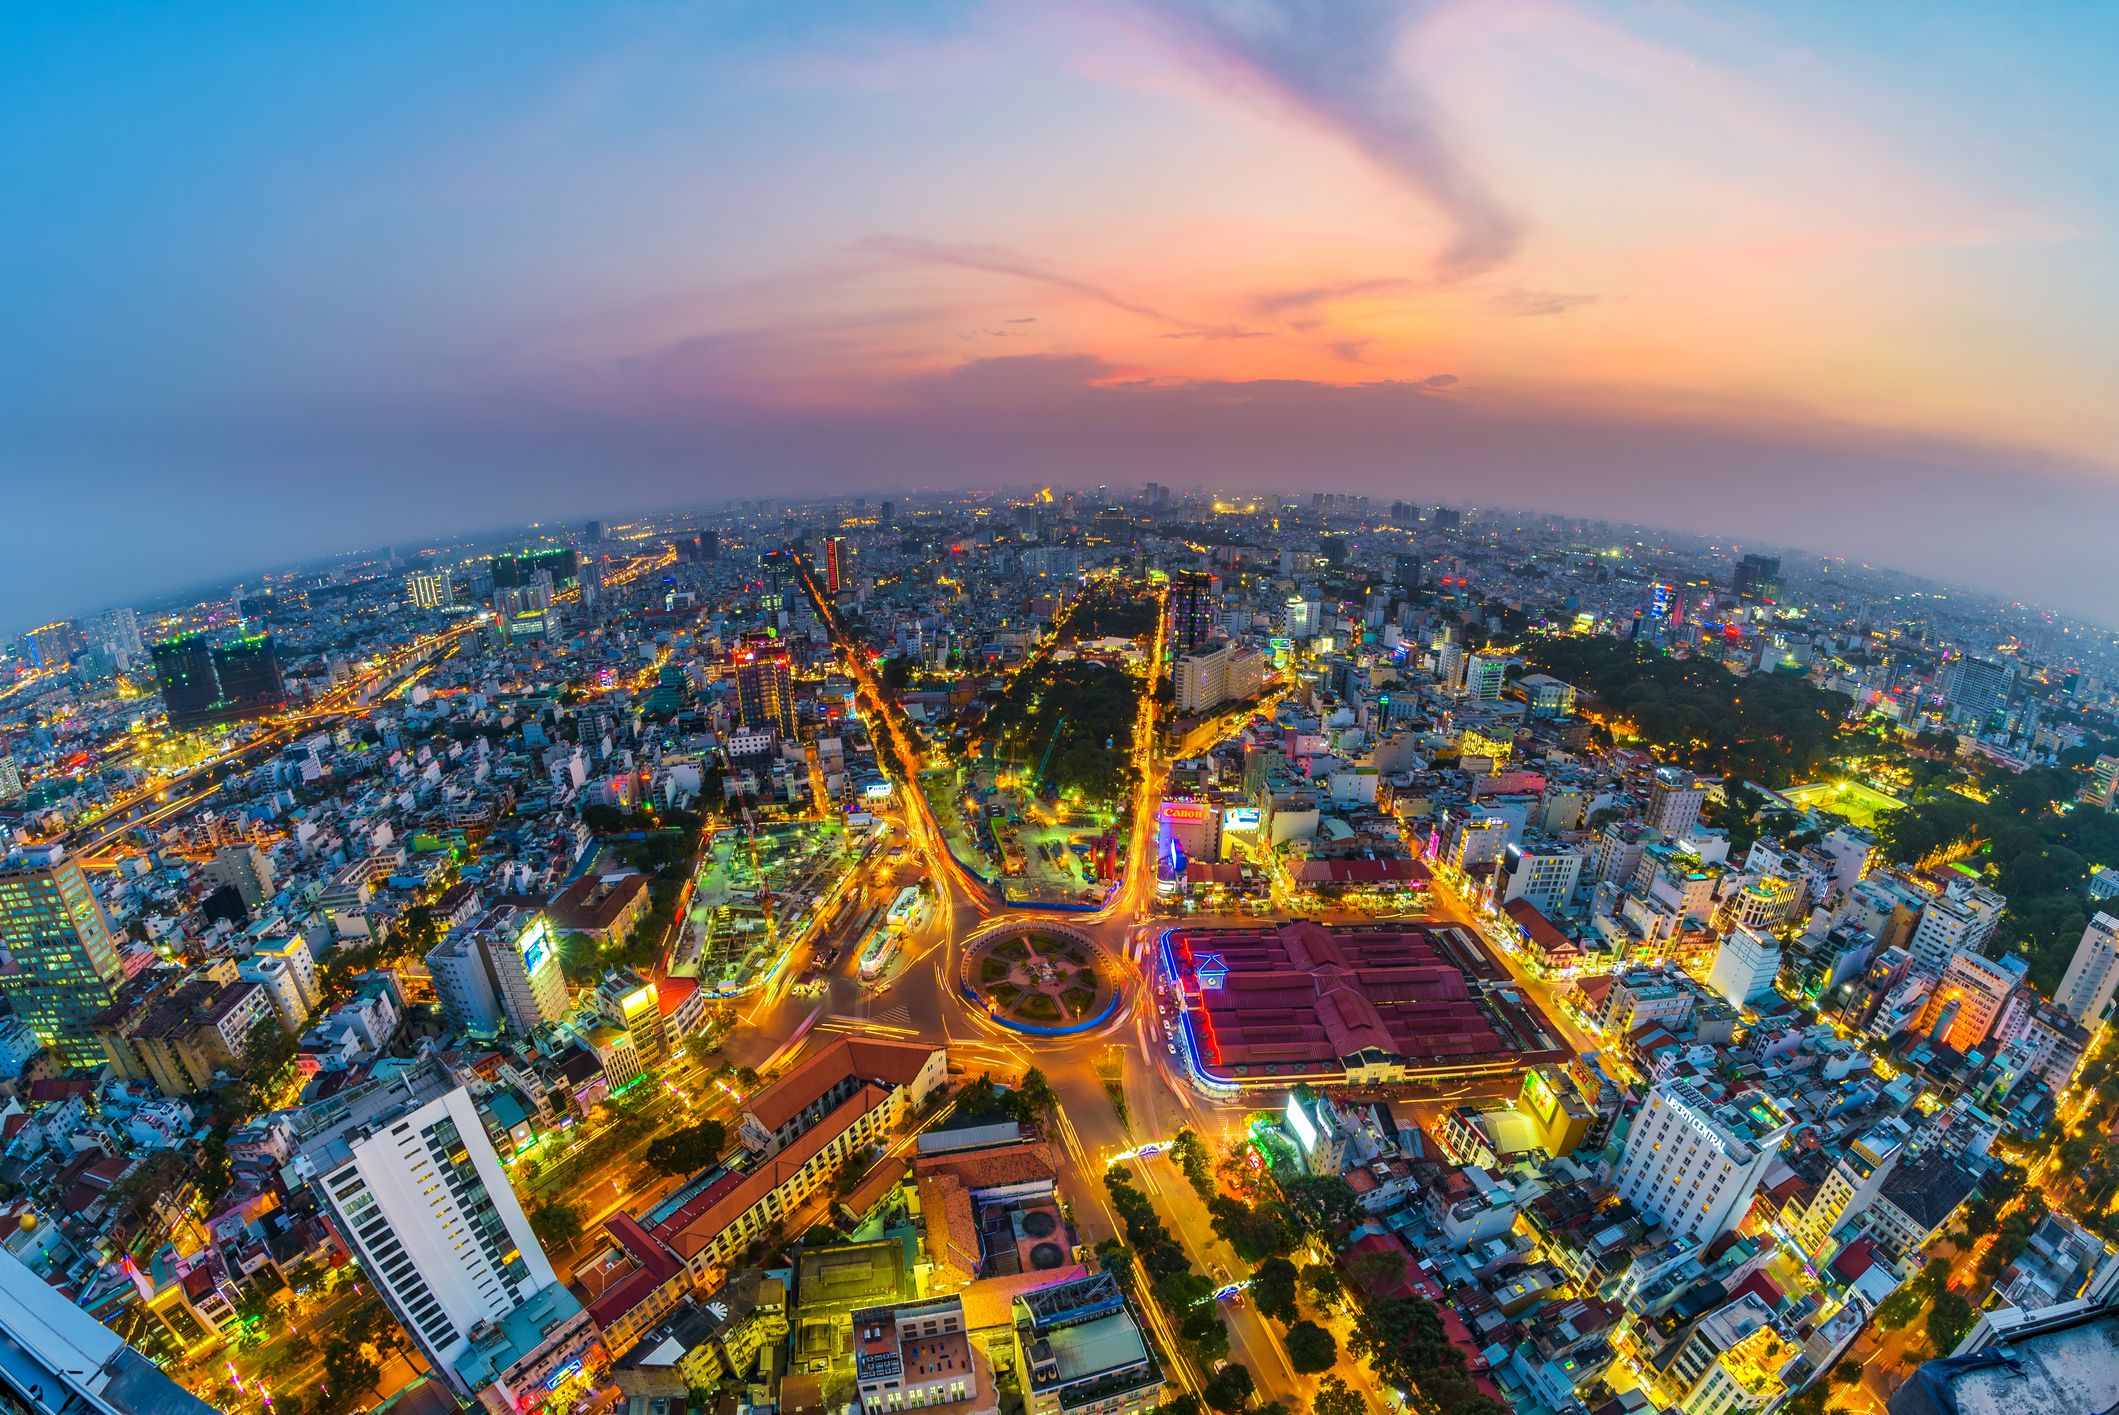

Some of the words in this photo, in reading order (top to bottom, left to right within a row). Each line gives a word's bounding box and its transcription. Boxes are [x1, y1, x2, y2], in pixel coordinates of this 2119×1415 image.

[1163, 808, 1203, 819] Canon
[1665, 1094, 1696, 1124] LIBERTY
[1691, 1116, 1727, 1153] CENTRAL
